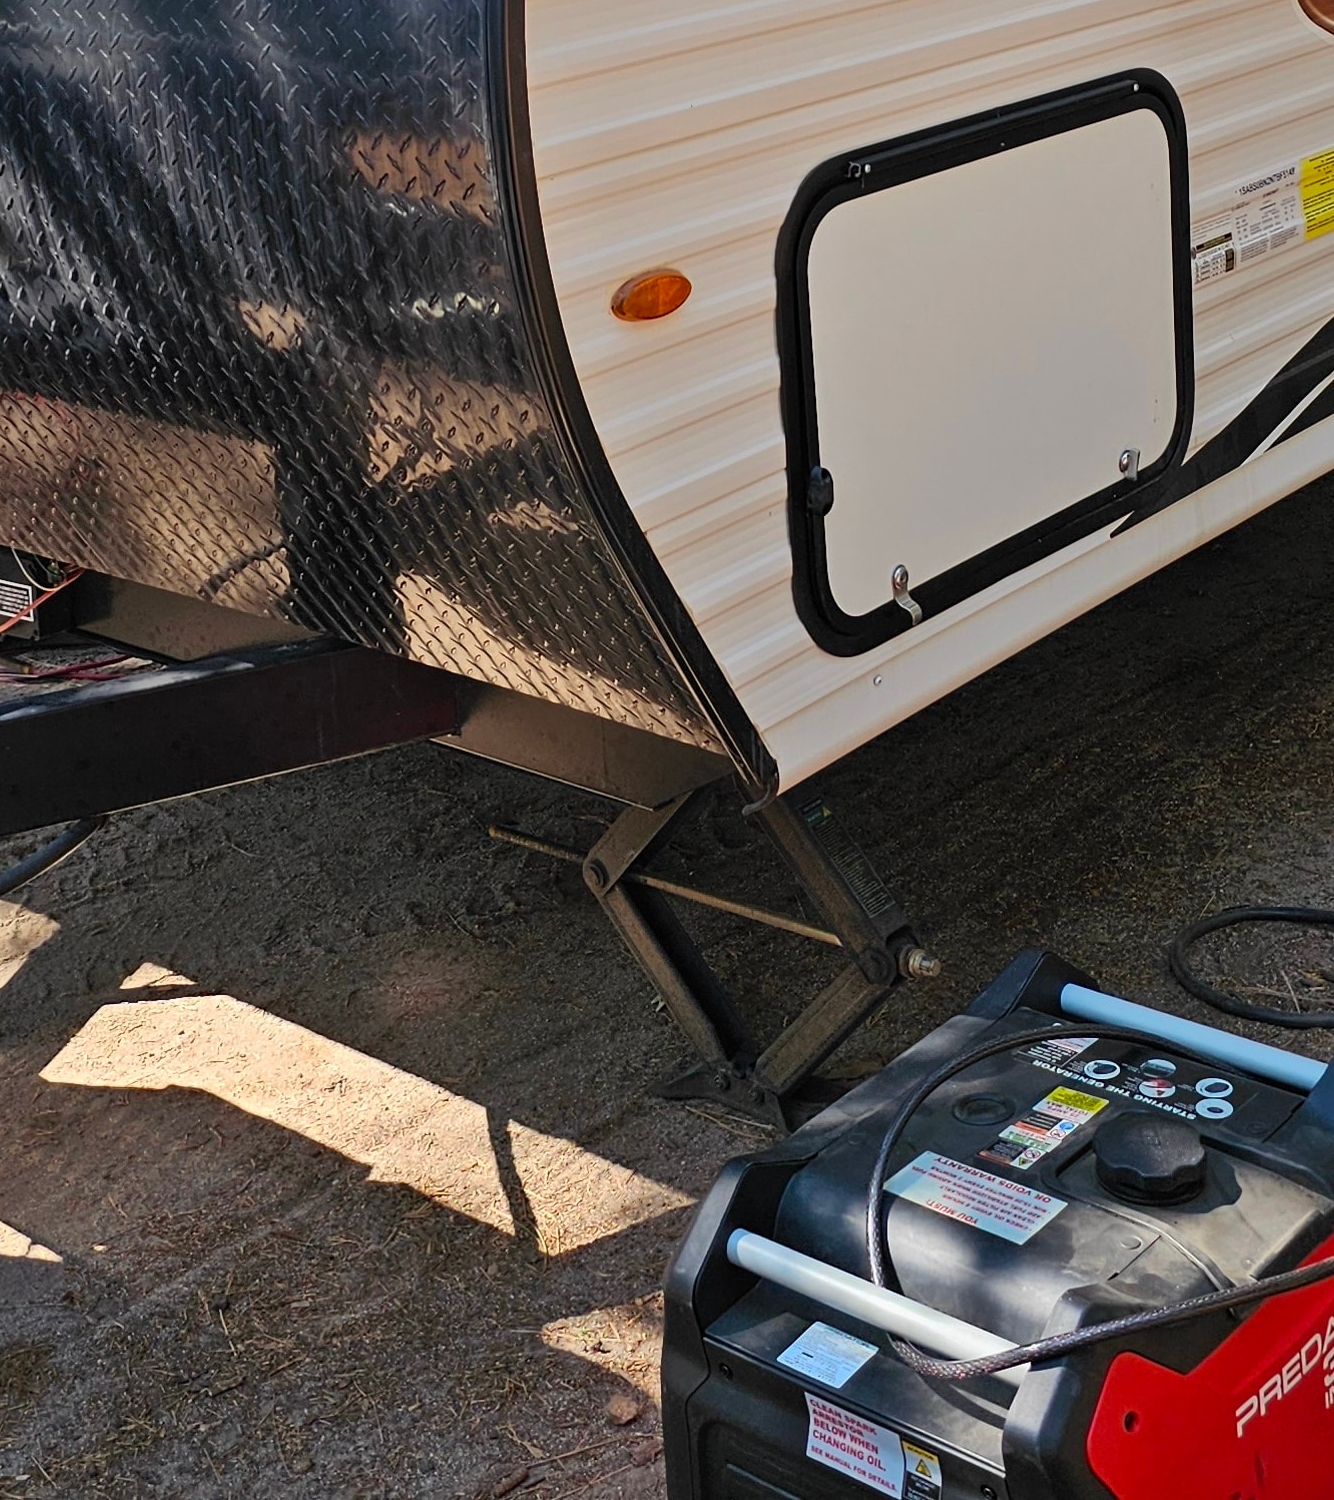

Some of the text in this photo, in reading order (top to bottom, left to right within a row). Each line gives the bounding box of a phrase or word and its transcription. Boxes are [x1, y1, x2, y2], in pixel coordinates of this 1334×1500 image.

[1032, 1059, 1104, 1088] GENERATOR
[1105, 1084, 1131, 1098] THE
[1133, 1093, 1197, 1120] STARTING
[934, 1156, 1051, 1203] OR VOIDS WARRANTY
[956, 1211, 979, 1225] YOU
[810, 1399, 877, 1435] CLEAN SPARK
[812, 1409, 864, 1437] ARRESTOR
[812, 1429, 887, 1472] CHANGING OIL.
[813, 1417, 879, 1455] BELOW WHEN
[811, 1445, 823, 1455] SEE
[825, 1452, 852, 1470] MANUAL
[853, 1465, 867, 1477] FOR
